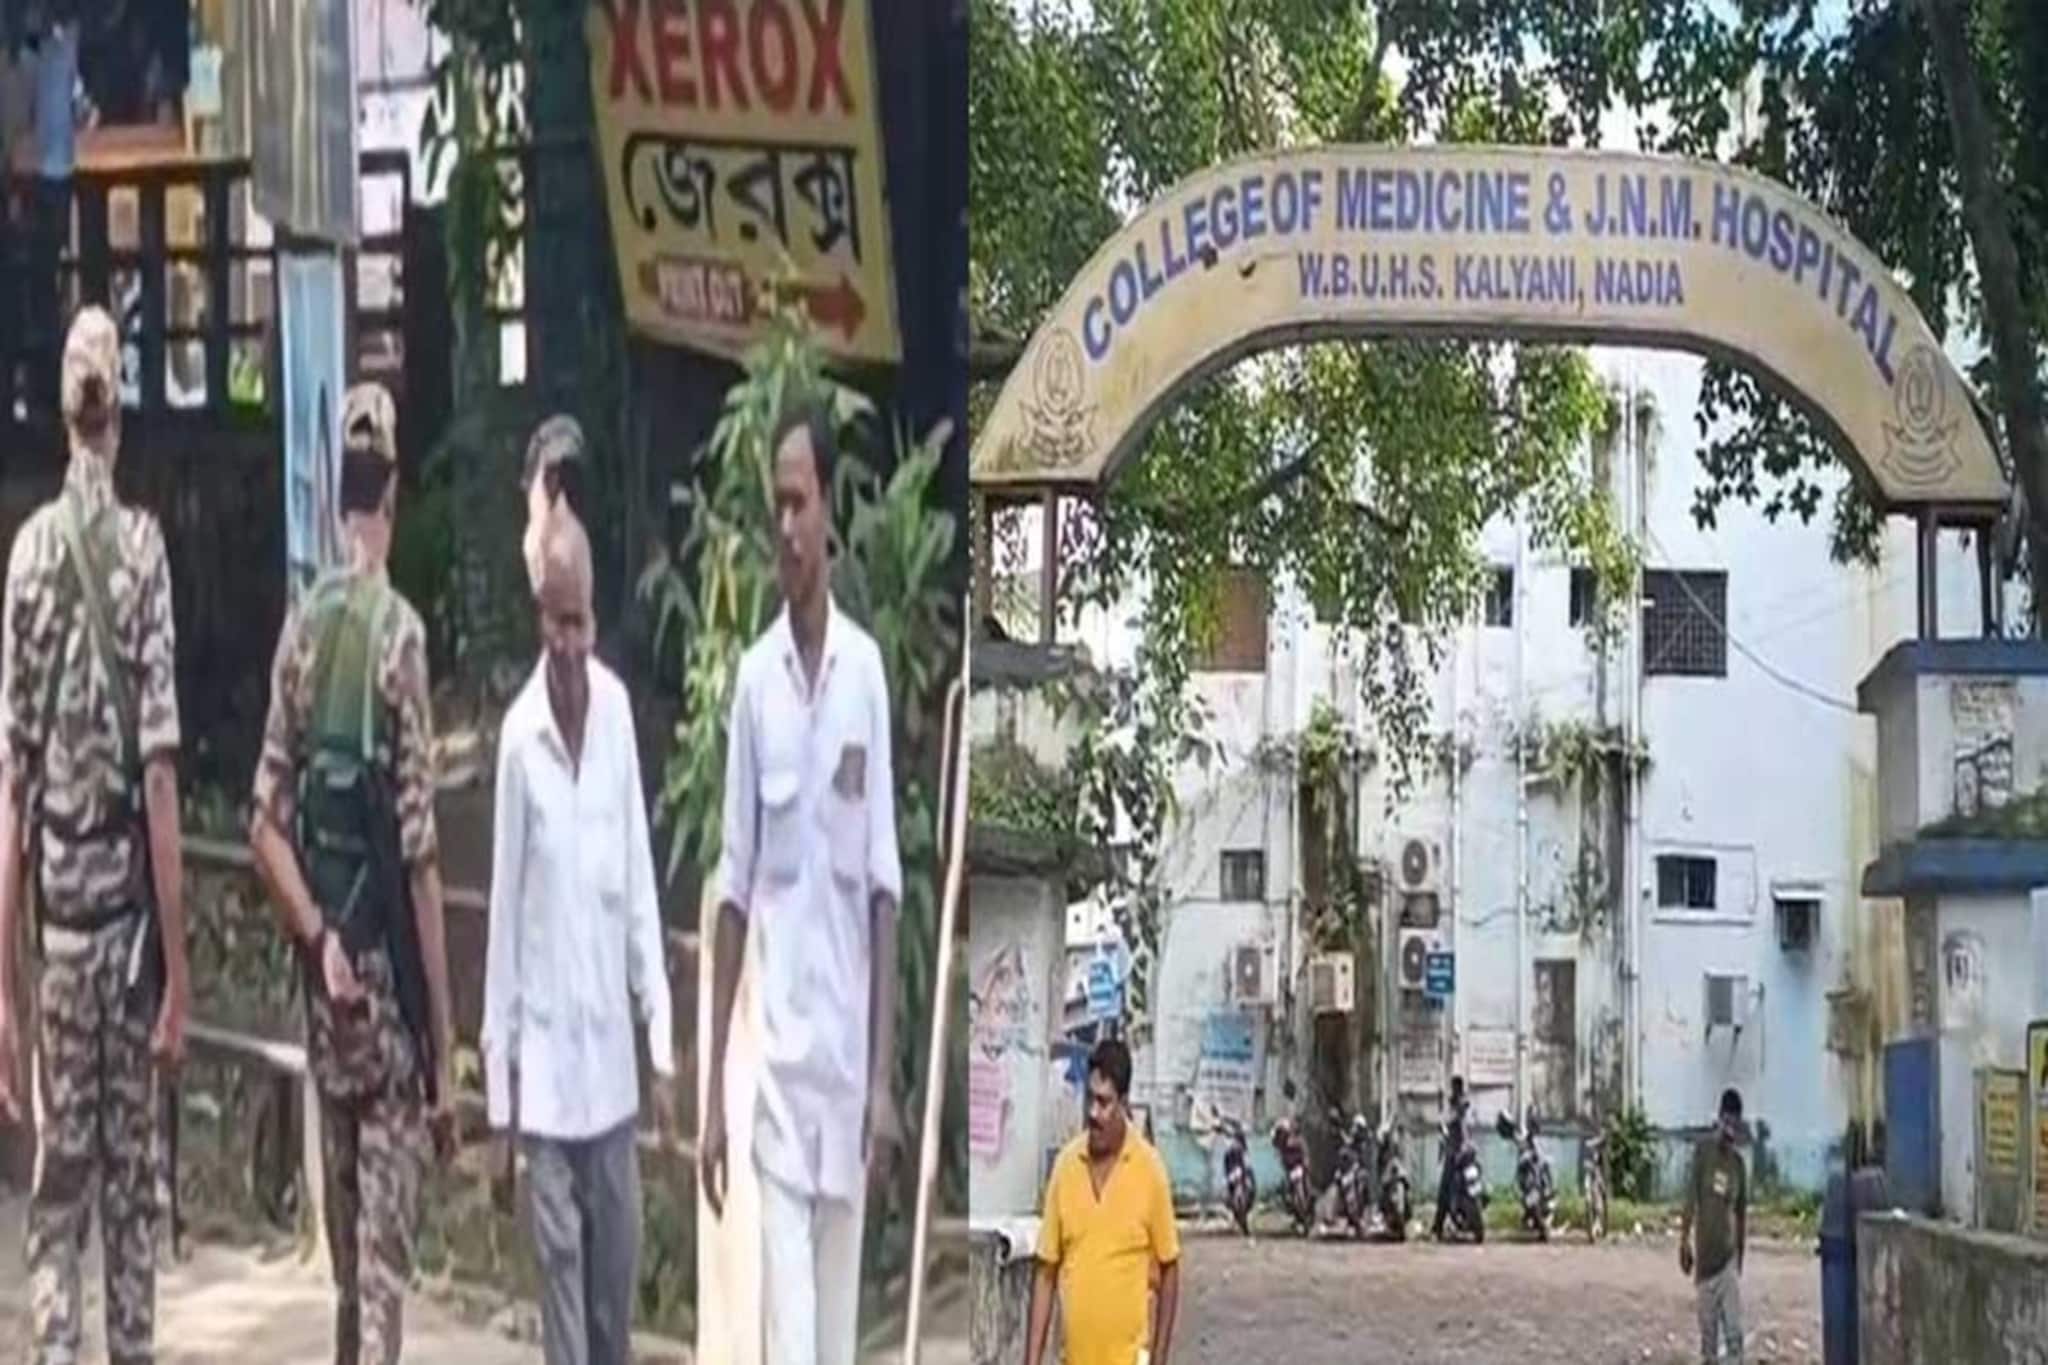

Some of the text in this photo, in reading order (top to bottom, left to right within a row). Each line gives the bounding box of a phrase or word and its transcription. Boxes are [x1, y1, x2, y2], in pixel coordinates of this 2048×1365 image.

[602, 0, 855, 115] XEROX
[621, 131, 862, 266] জেরক্স
[1081, 168, 1903, 386] COLLEGE OF MEDICINE & J.N.M. HOSPITAL
[1298, 252, 1684, 309] W.B.U.H.S. KALYANI, NADIA
